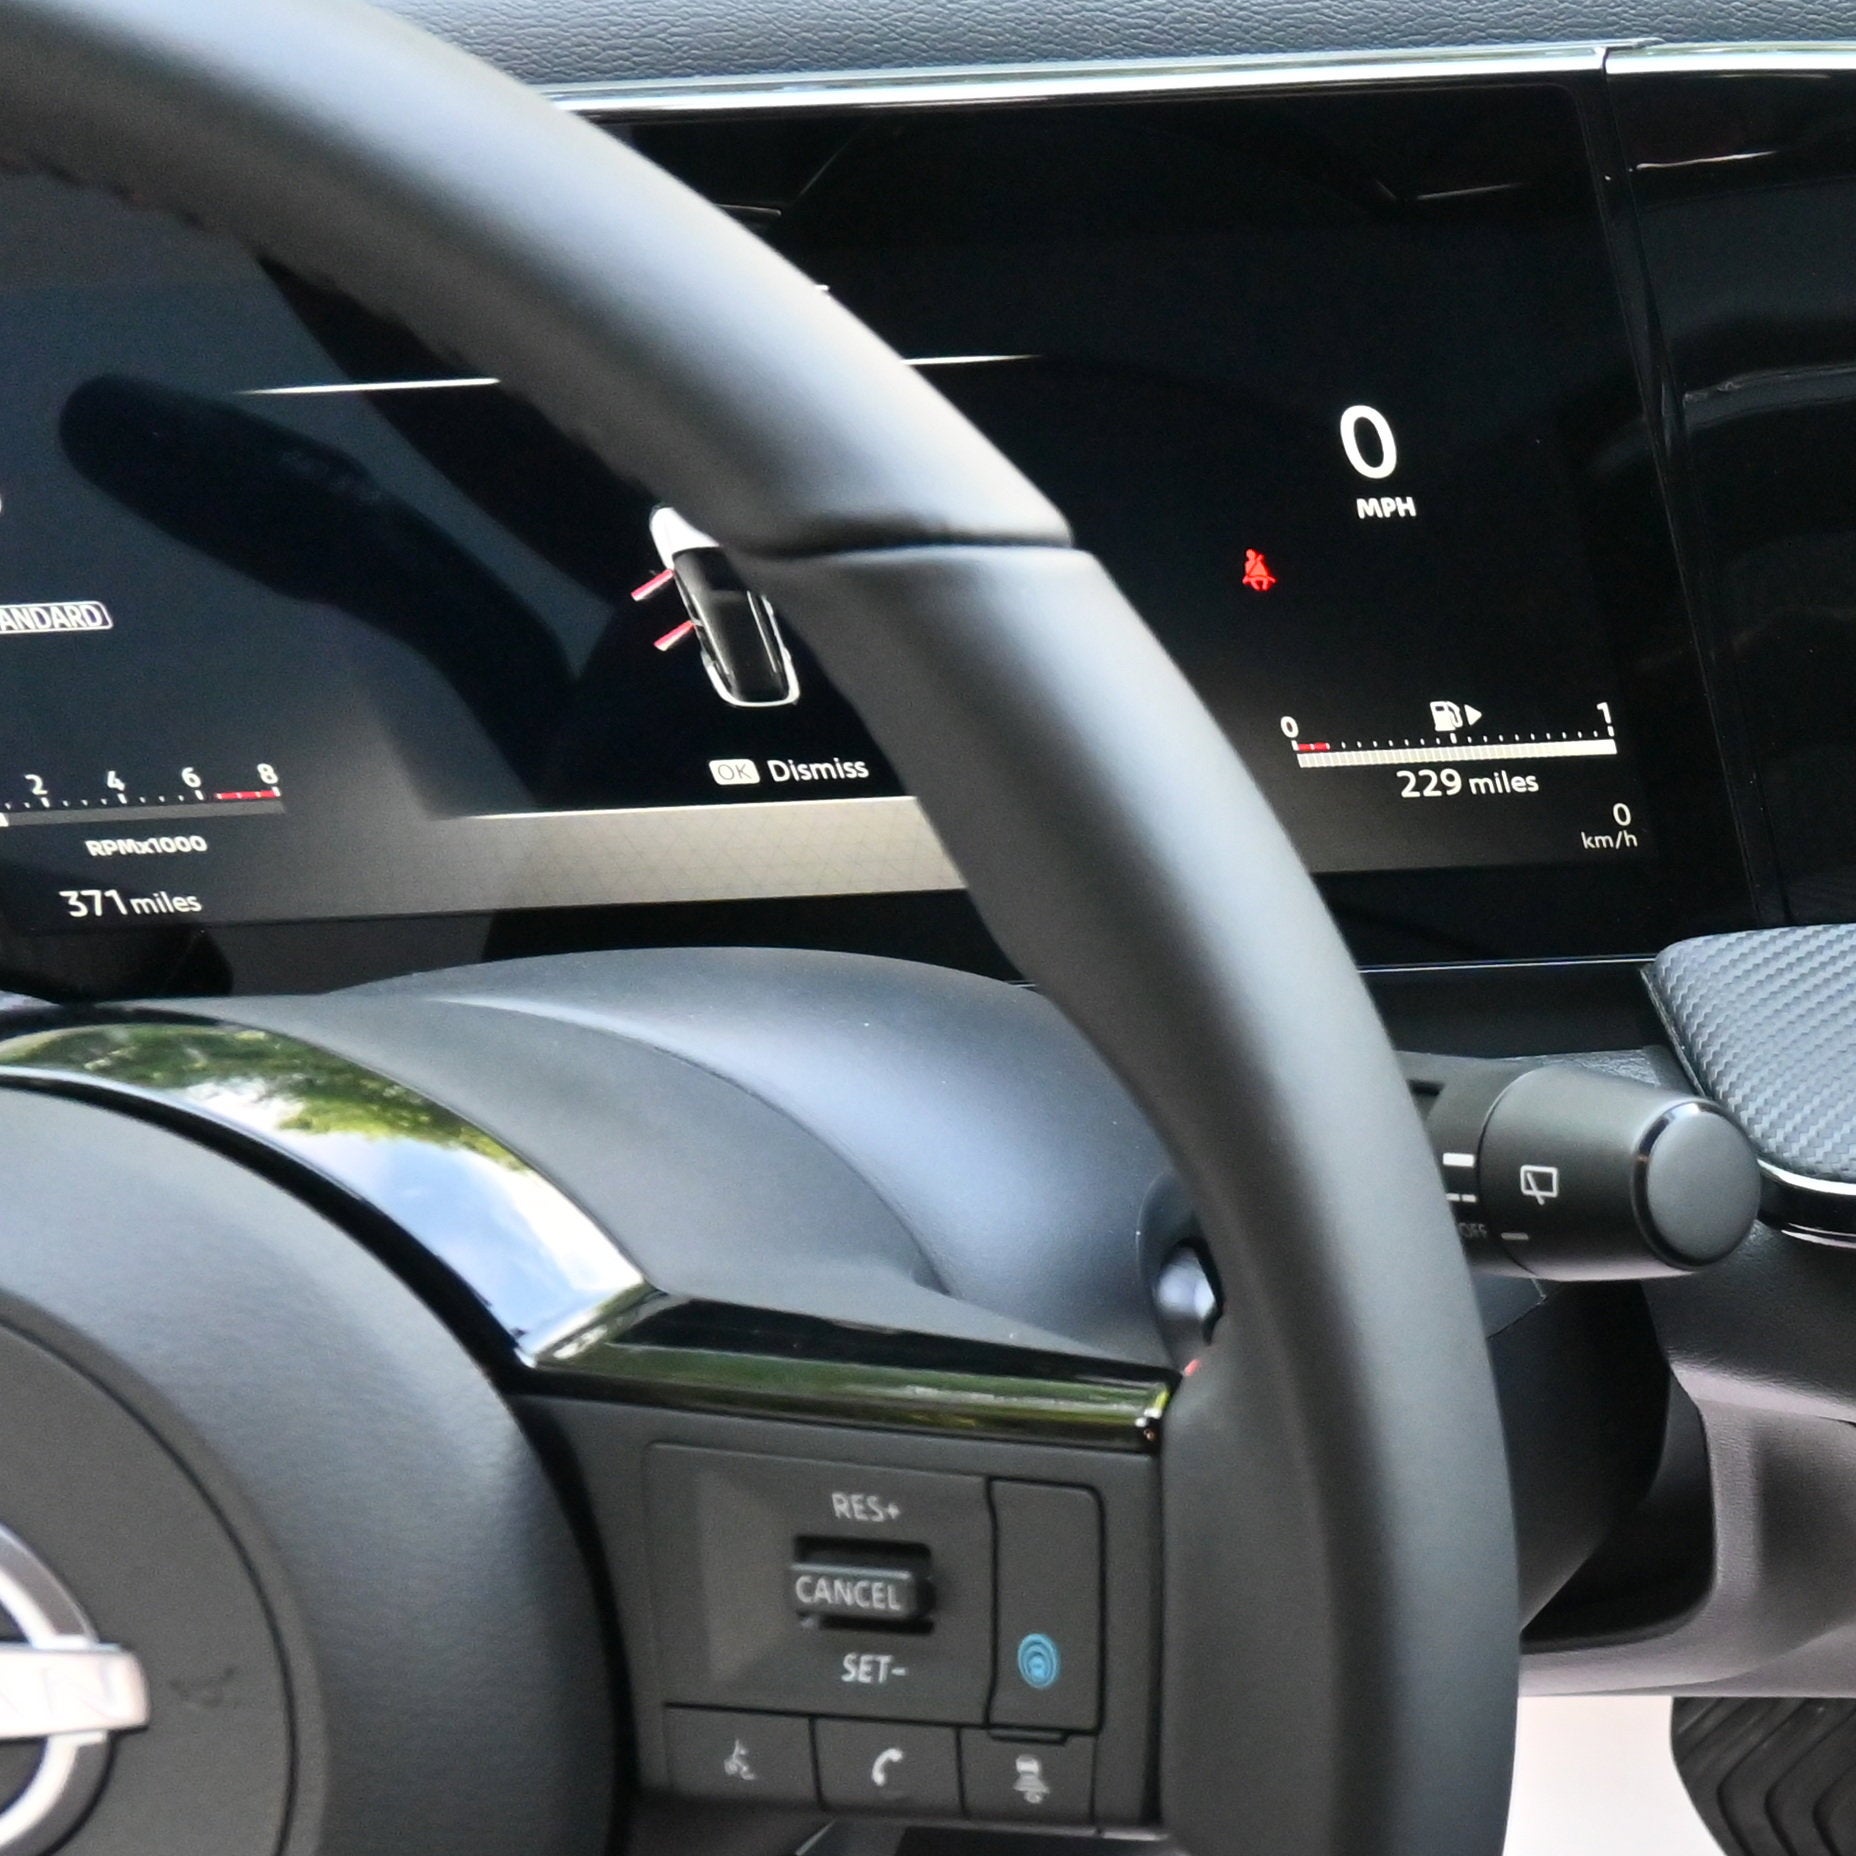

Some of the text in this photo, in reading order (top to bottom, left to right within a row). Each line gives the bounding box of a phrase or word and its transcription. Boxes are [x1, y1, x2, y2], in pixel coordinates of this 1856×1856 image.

[1340, 405, 1397, 479] 0
[1356, 497, 1417, 519] MPH
[1597, 703, 1612, 726] 1
[1280, 716, 1299, 738] 0
[106, 770, 125, 791] 4
[181, 767, 201, 788] 6
[257, 763, 278, 784] 8
[717, 757, 869, 782] OK Dismiss
[24, 774, 48, 795] 2
[1397, 768, 1539, 798] 229 miles
[1613, 803, 1631, 827] 0
[85, 835, 208, 857] RPMx1000
[1581, 829, 1638, 850] km/h
[59, 889, 202, 917] 371 miles
[832, 1491, 900, 1523] RES+
[796, 1576, 900, 1611] CANCEL
[841, 1653, 907, 1685] SET-
